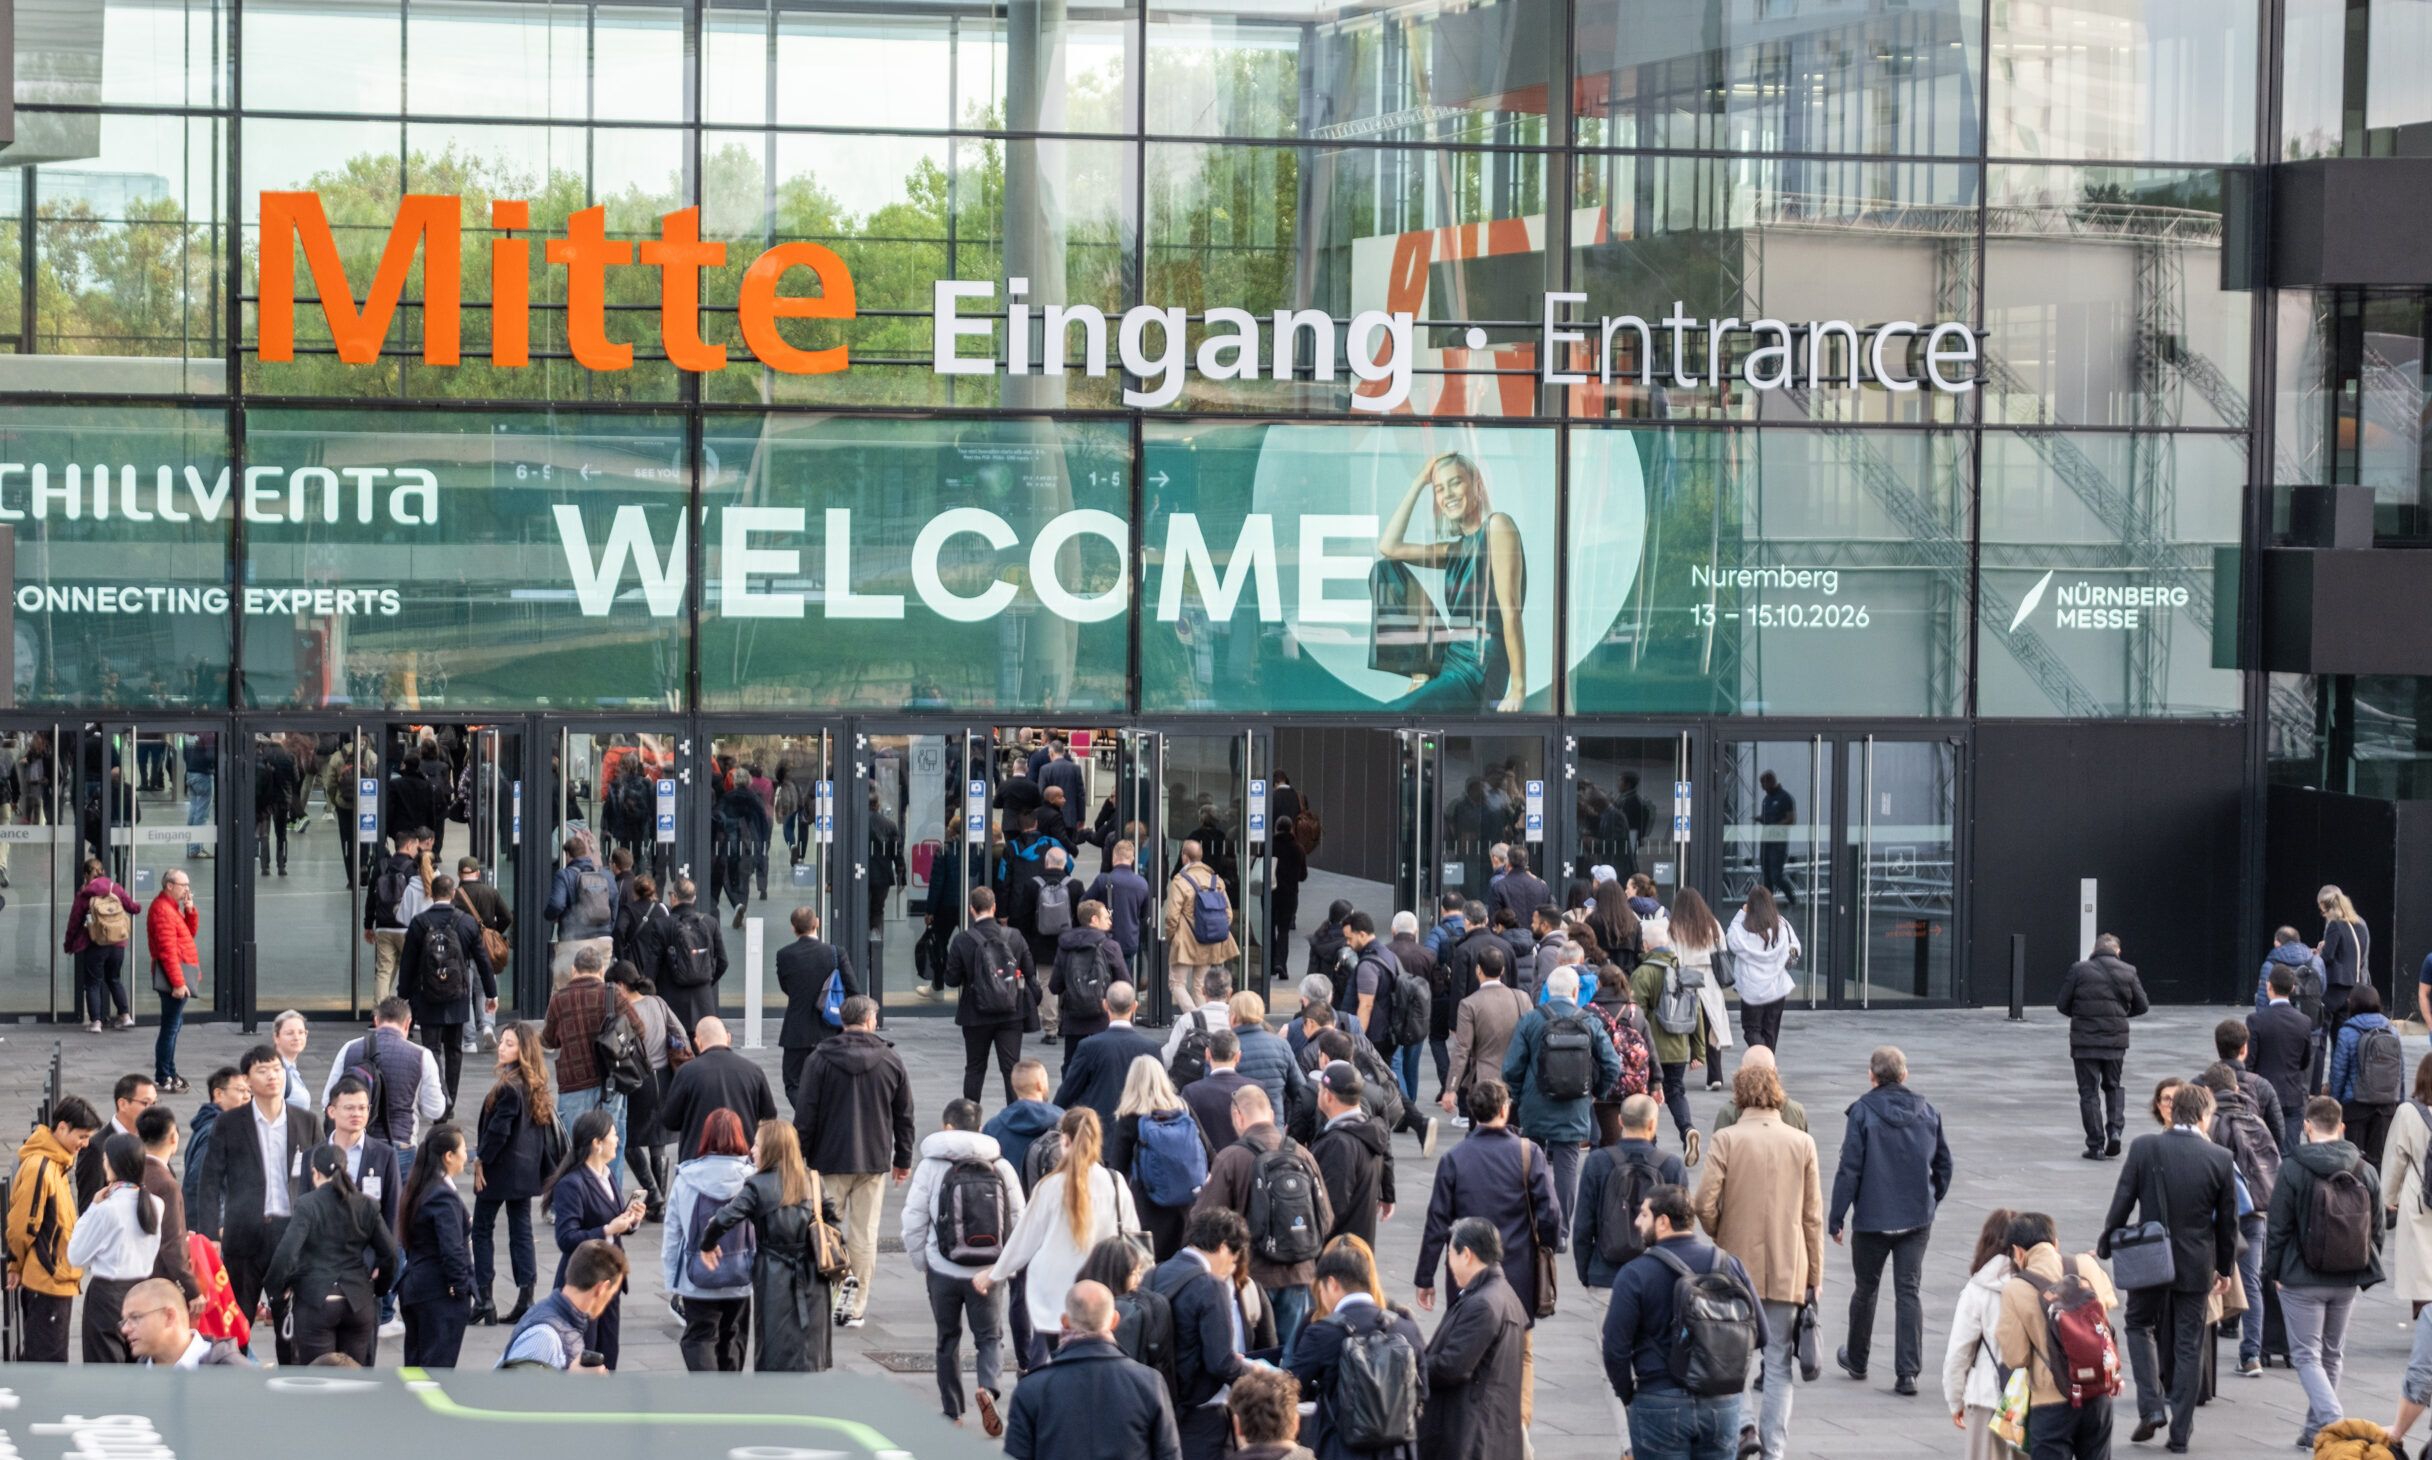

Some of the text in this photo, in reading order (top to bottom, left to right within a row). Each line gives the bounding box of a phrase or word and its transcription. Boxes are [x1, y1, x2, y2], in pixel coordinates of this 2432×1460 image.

[258, 190, 856, 375] Mitte
[933, 276, 1415, 413] Eingang
[1542, 291, 1977, 394] Entrance
[634, 467, 656, 479] SEE
[552, 503, 1380, 624] WELCOME
[1691, 564, 1838, 595] Nuremberg
[13, 585, 401, 616] ONNECTING EXPERTS
[2057, 581, 2190, 607] NÜRNBERG
[1690, 603, 1717, 627] 13
[1747, 604, 1870, 628] 15.10.2026
[2056, 608, 2139, 629] MESSE
[0, 830, 29, 839] ance
[148, 830, 192, 842] Eingang
